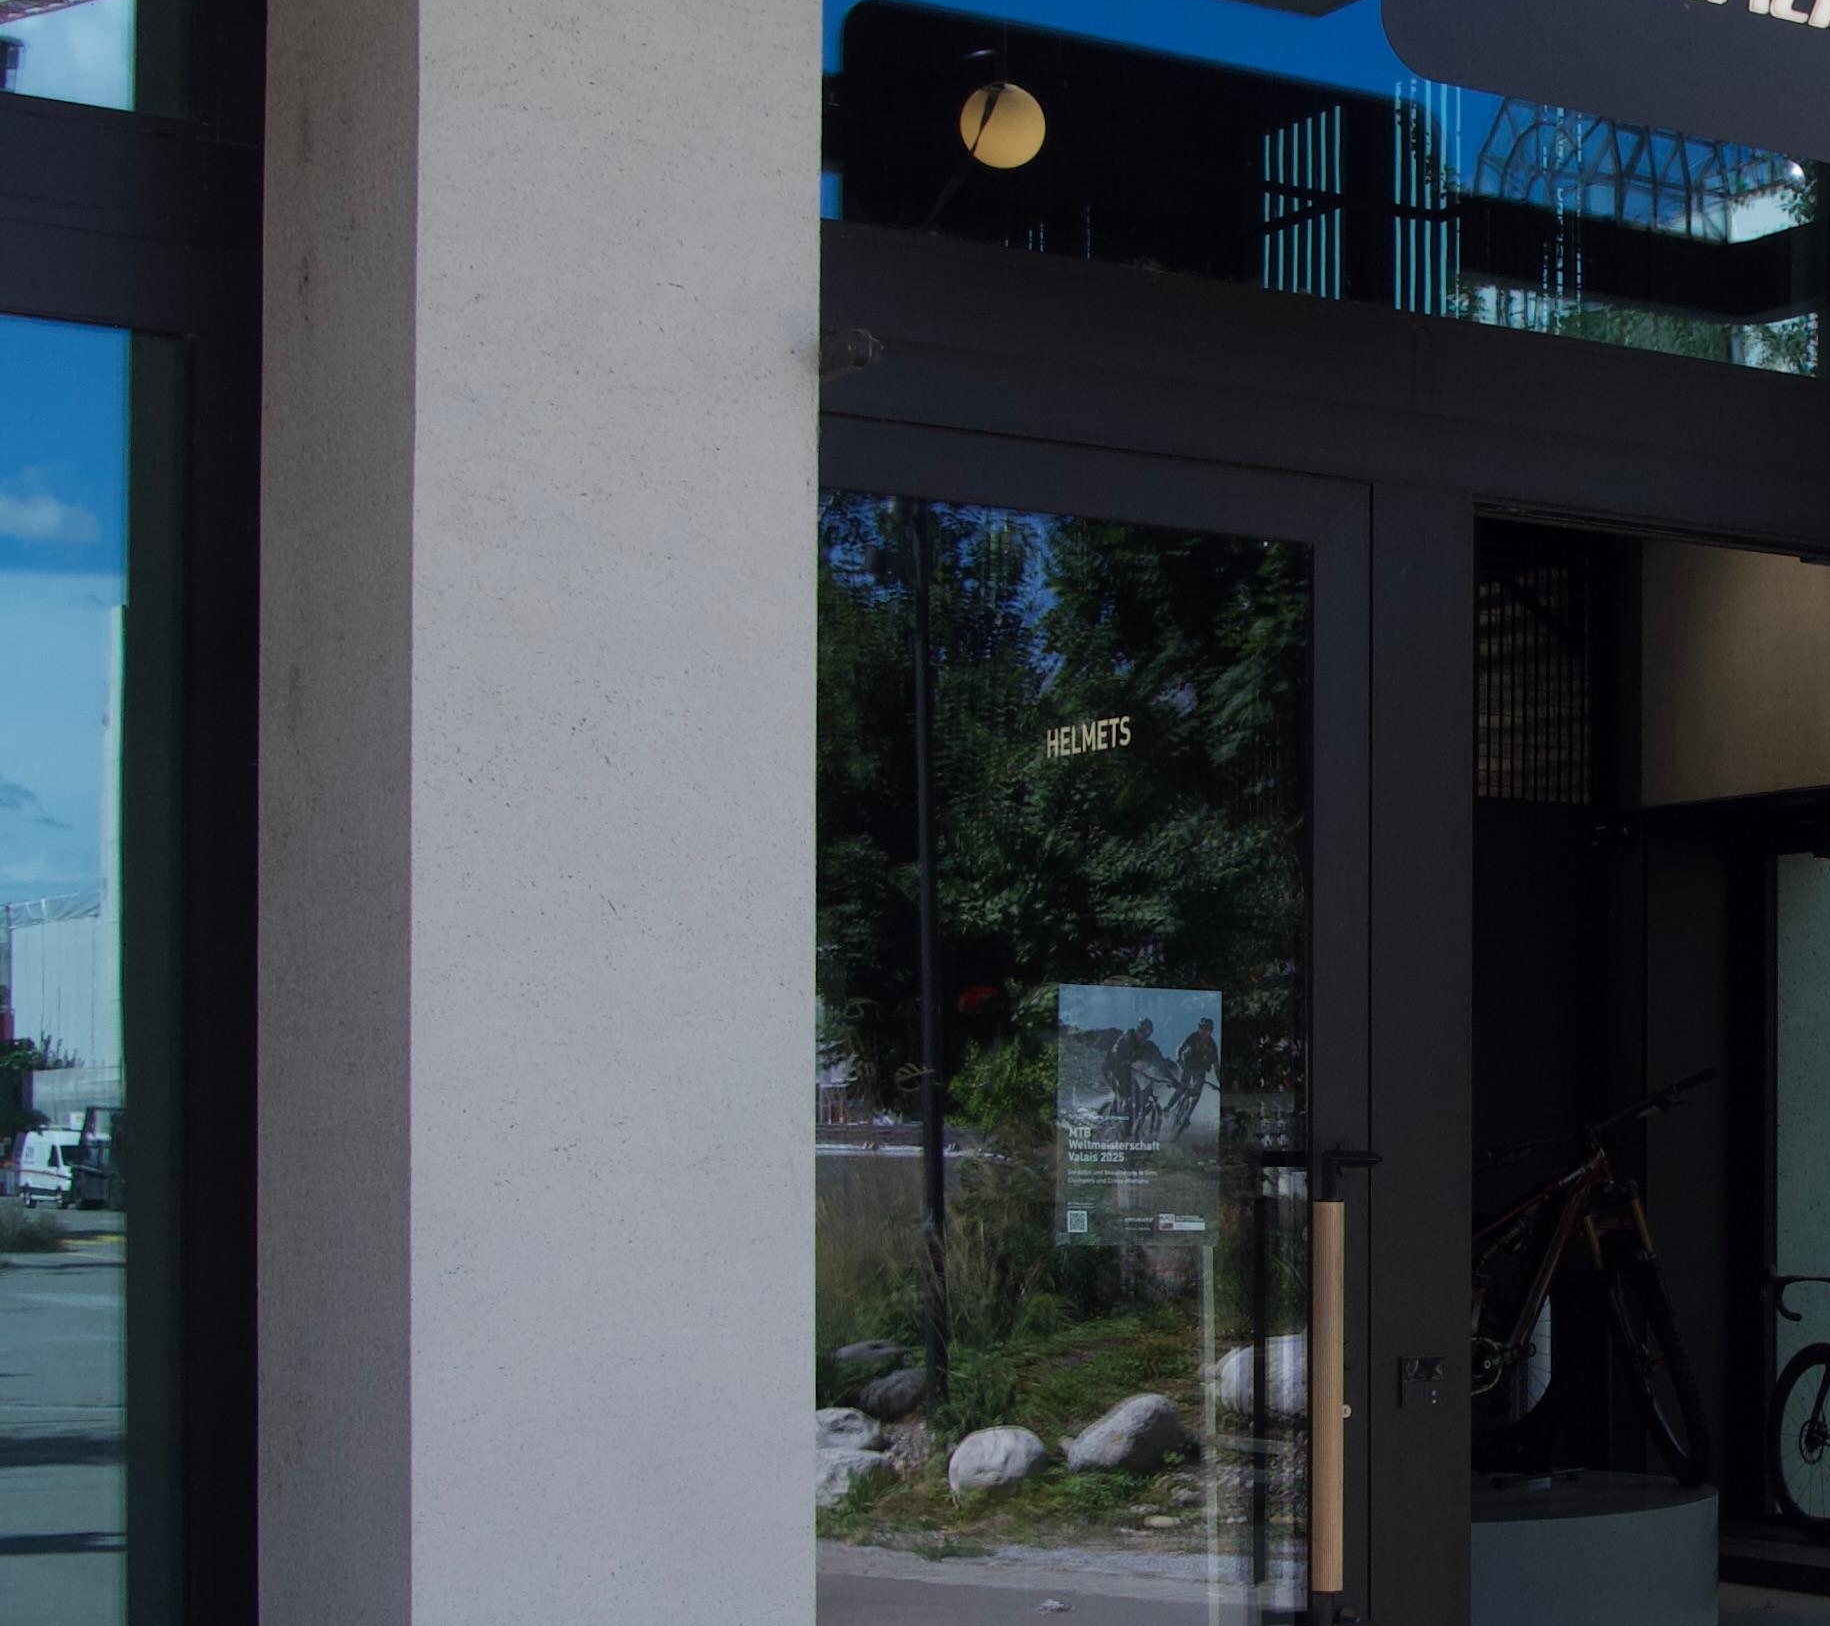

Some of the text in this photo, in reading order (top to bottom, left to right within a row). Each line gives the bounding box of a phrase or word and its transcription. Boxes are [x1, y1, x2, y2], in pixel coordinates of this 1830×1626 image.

[1046, 715, 1132, 759] HELMETS
[1068, 1126, 1092, 1138] MTB
[1068, 1139, 1161, 1151] Weltmeisterschaft
[1067, 1151, 1125, 1162] Valais 2025
